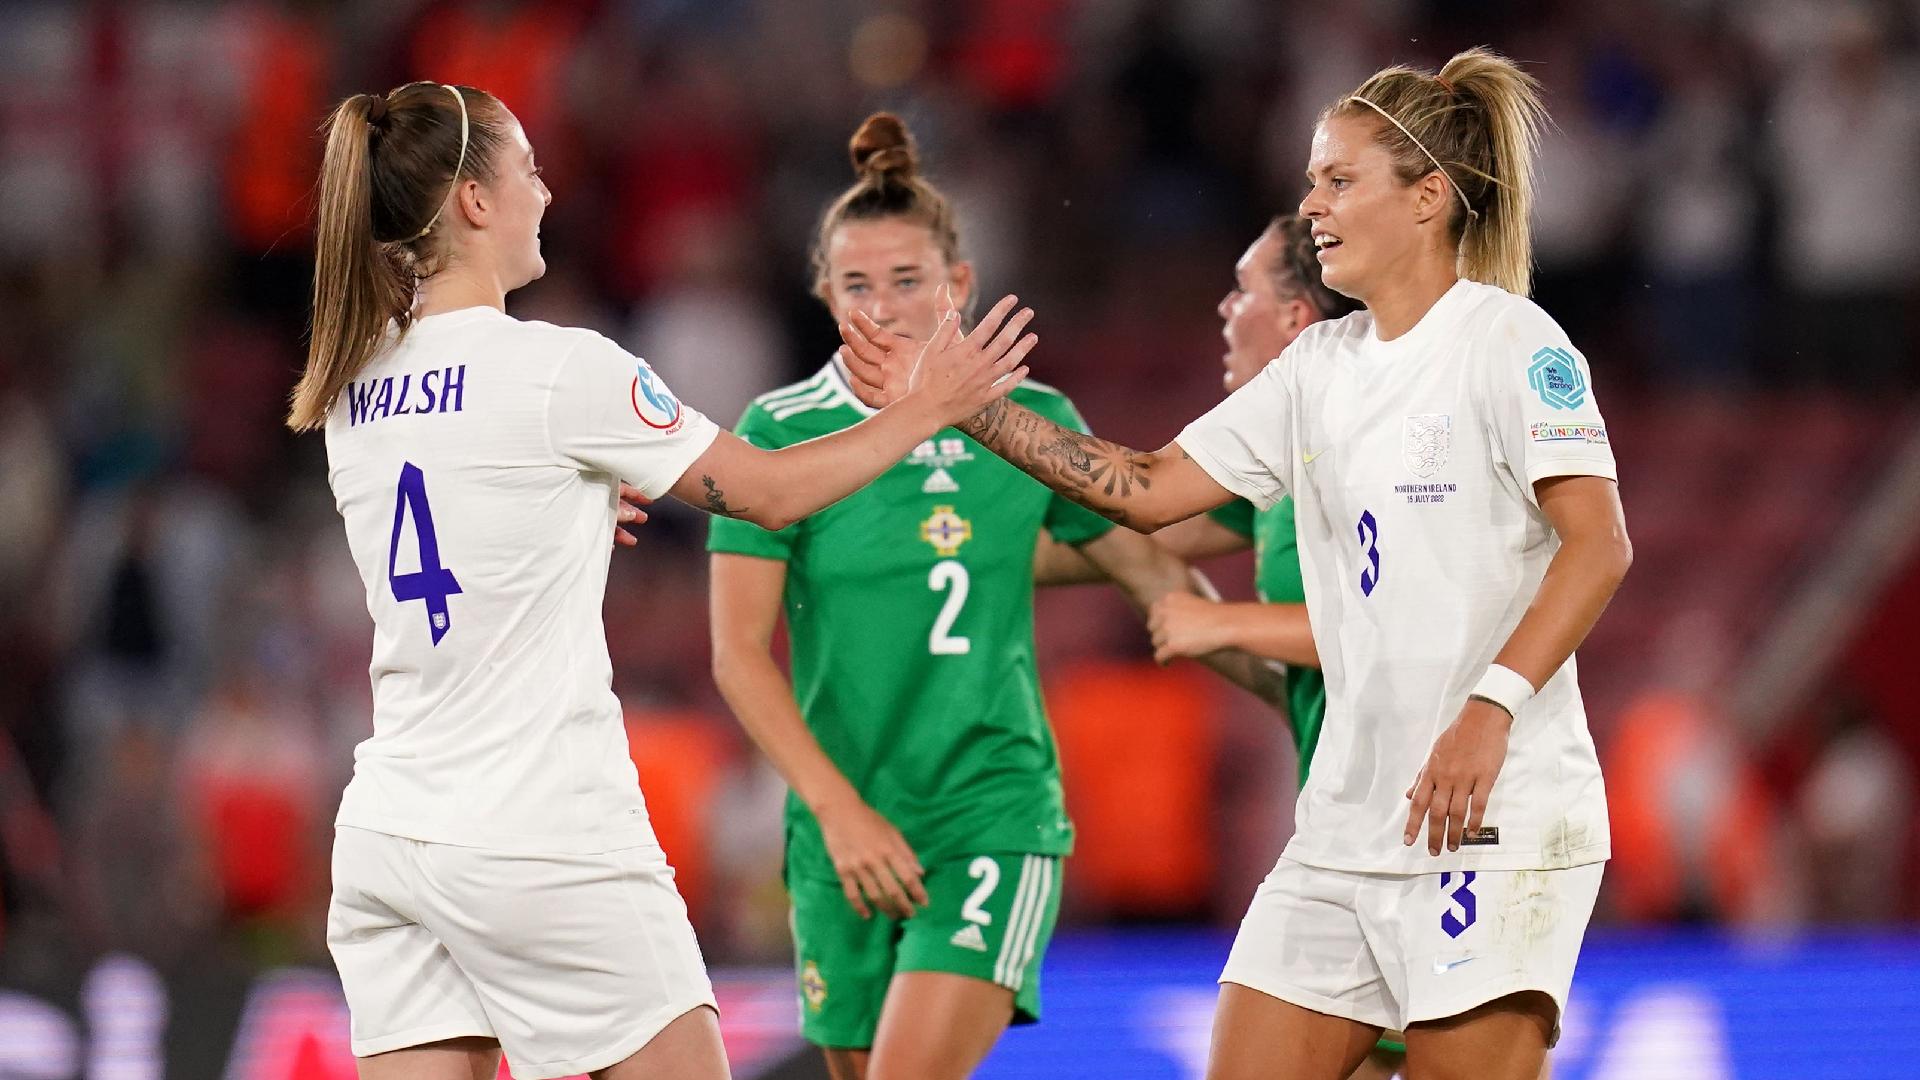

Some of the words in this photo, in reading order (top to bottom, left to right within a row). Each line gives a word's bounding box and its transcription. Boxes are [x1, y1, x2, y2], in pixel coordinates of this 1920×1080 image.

[348, 364, 466, 427] WALSH
[1548, 374, 1564, 383] Play
[1549, 382, 1573, 391] Strong
[1531, 427, 1605, 438] FOUNDATION
[1394, 484, 1428, 494] NORTHERN
[1428, 483, 1457, 492] IRELAND
[1407, 495, 1413, 503] 15
[1415, 495, 1430, 503] JULY
[1430, 494, 1445, 503] 2022
[388, 461, 463, 648] 4
[1357, 509, 1380, 597] 3
[928, 559, 971, 656] 2
[961, 855, 1001, 926] 2
[1440, 870, 1477, 939] 3
